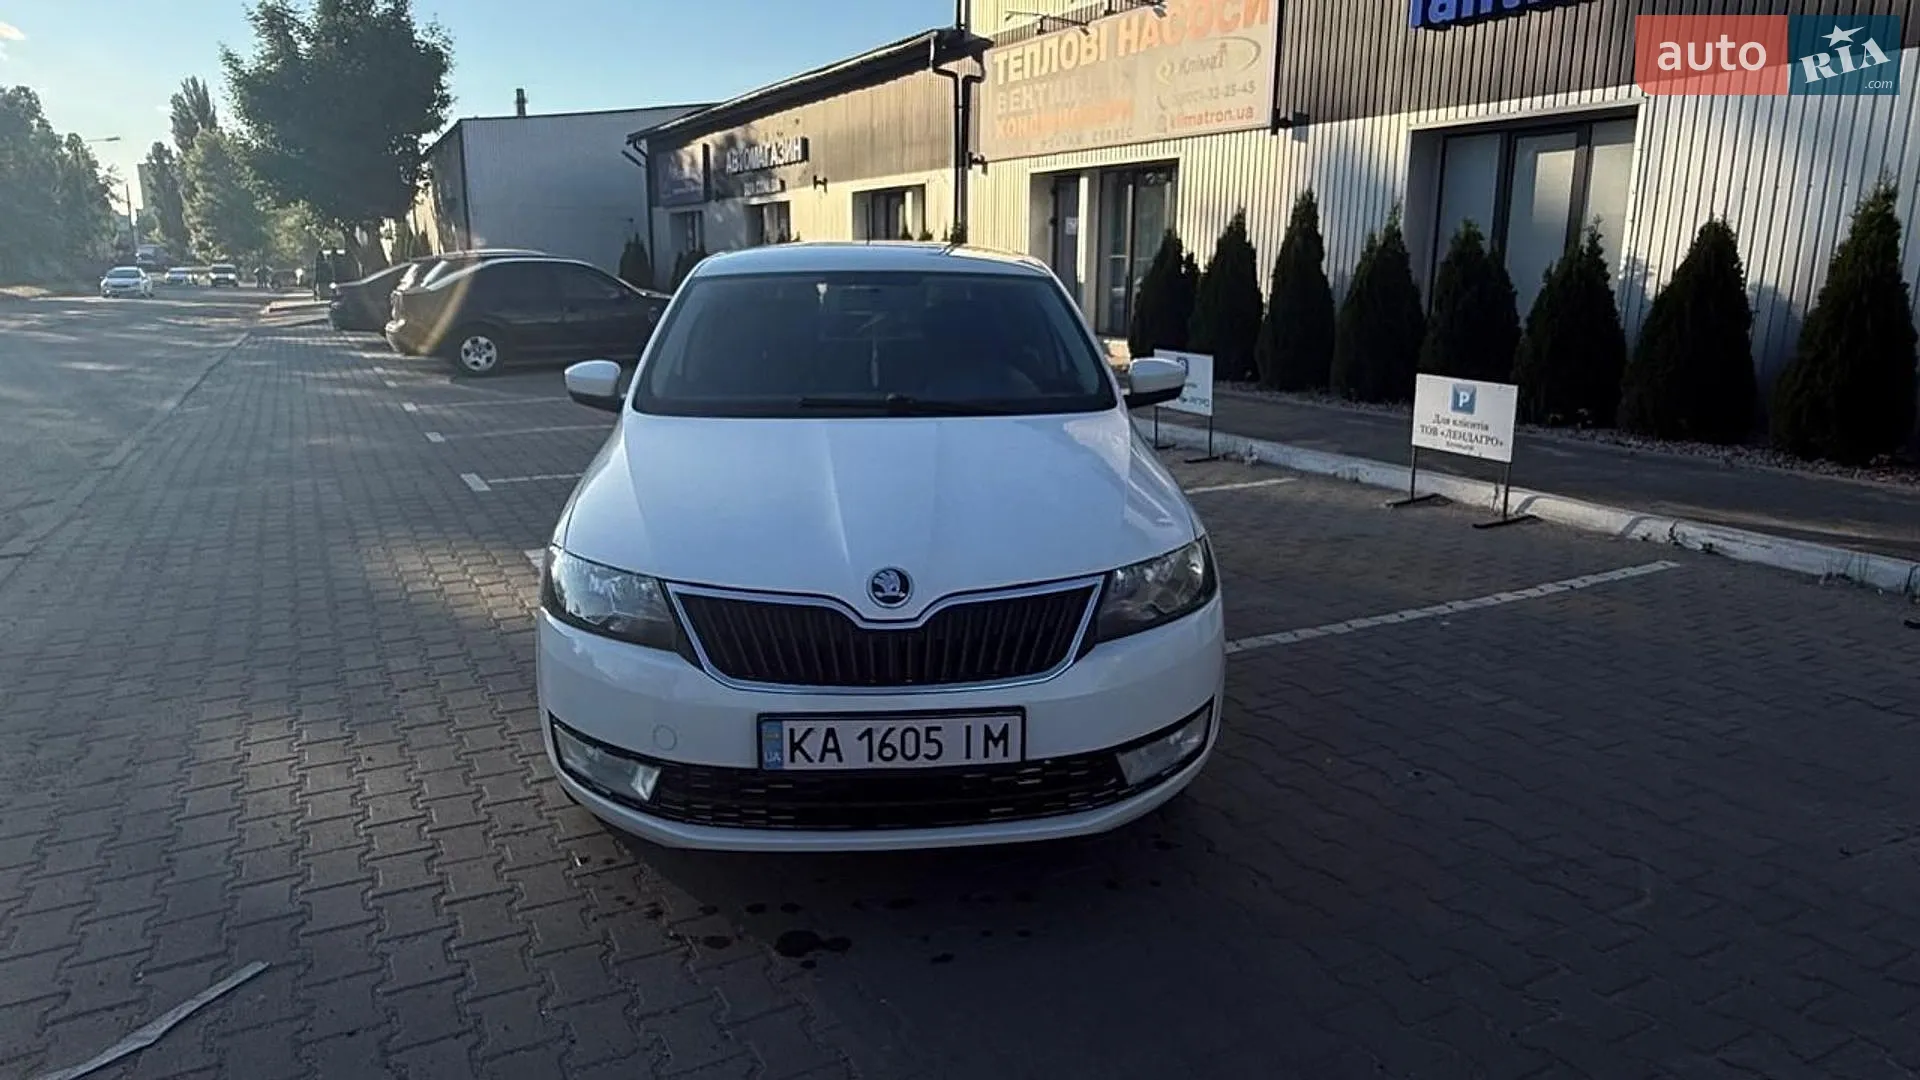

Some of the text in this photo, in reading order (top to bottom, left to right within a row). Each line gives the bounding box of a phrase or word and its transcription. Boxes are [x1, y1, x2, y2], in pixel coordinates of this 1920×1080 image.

[993, 0, 1269, 85] ТЕПЛОВІ НАСОСИ
[726, 137, 801, 175] АВТОМАГАЗИН
[1420, 424, 1438, 436] ТОВ
[1432, 413, 1450, 426] Для
[789, 723, 1009, 763] KA 1605 IM
